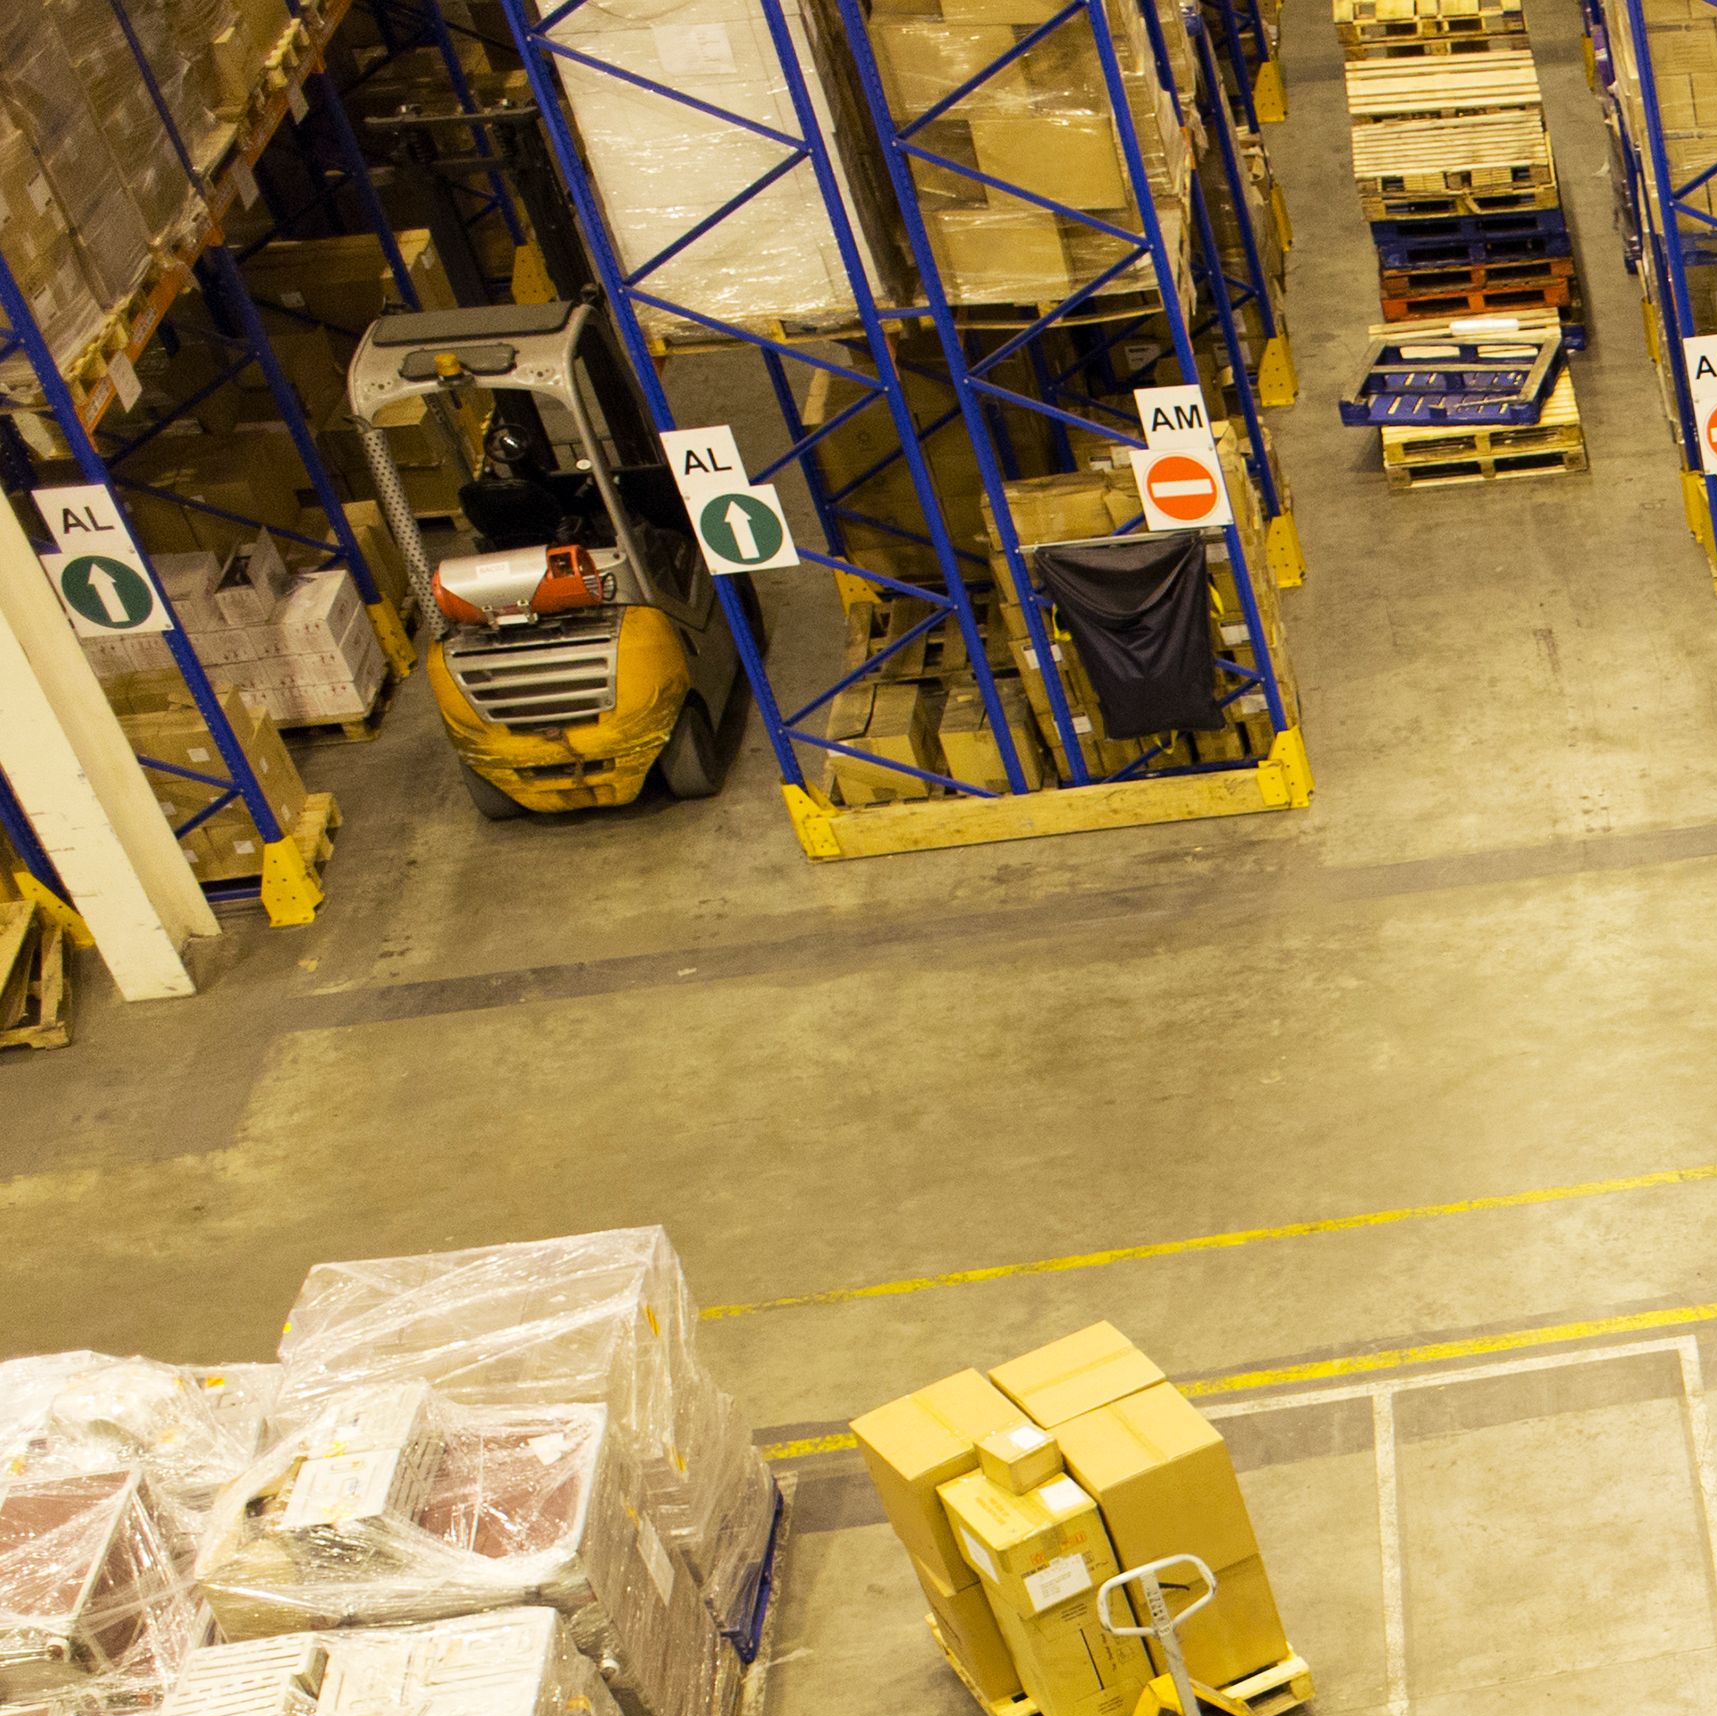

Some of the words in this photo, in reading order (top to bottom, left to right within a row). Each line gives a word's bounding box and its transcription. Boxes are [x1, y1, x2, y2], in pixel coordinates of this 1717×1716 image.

[1152, 404, 1206, 432] AM
[684, 447, 732, 475] AL
[62, 506, 114, 534] AL
